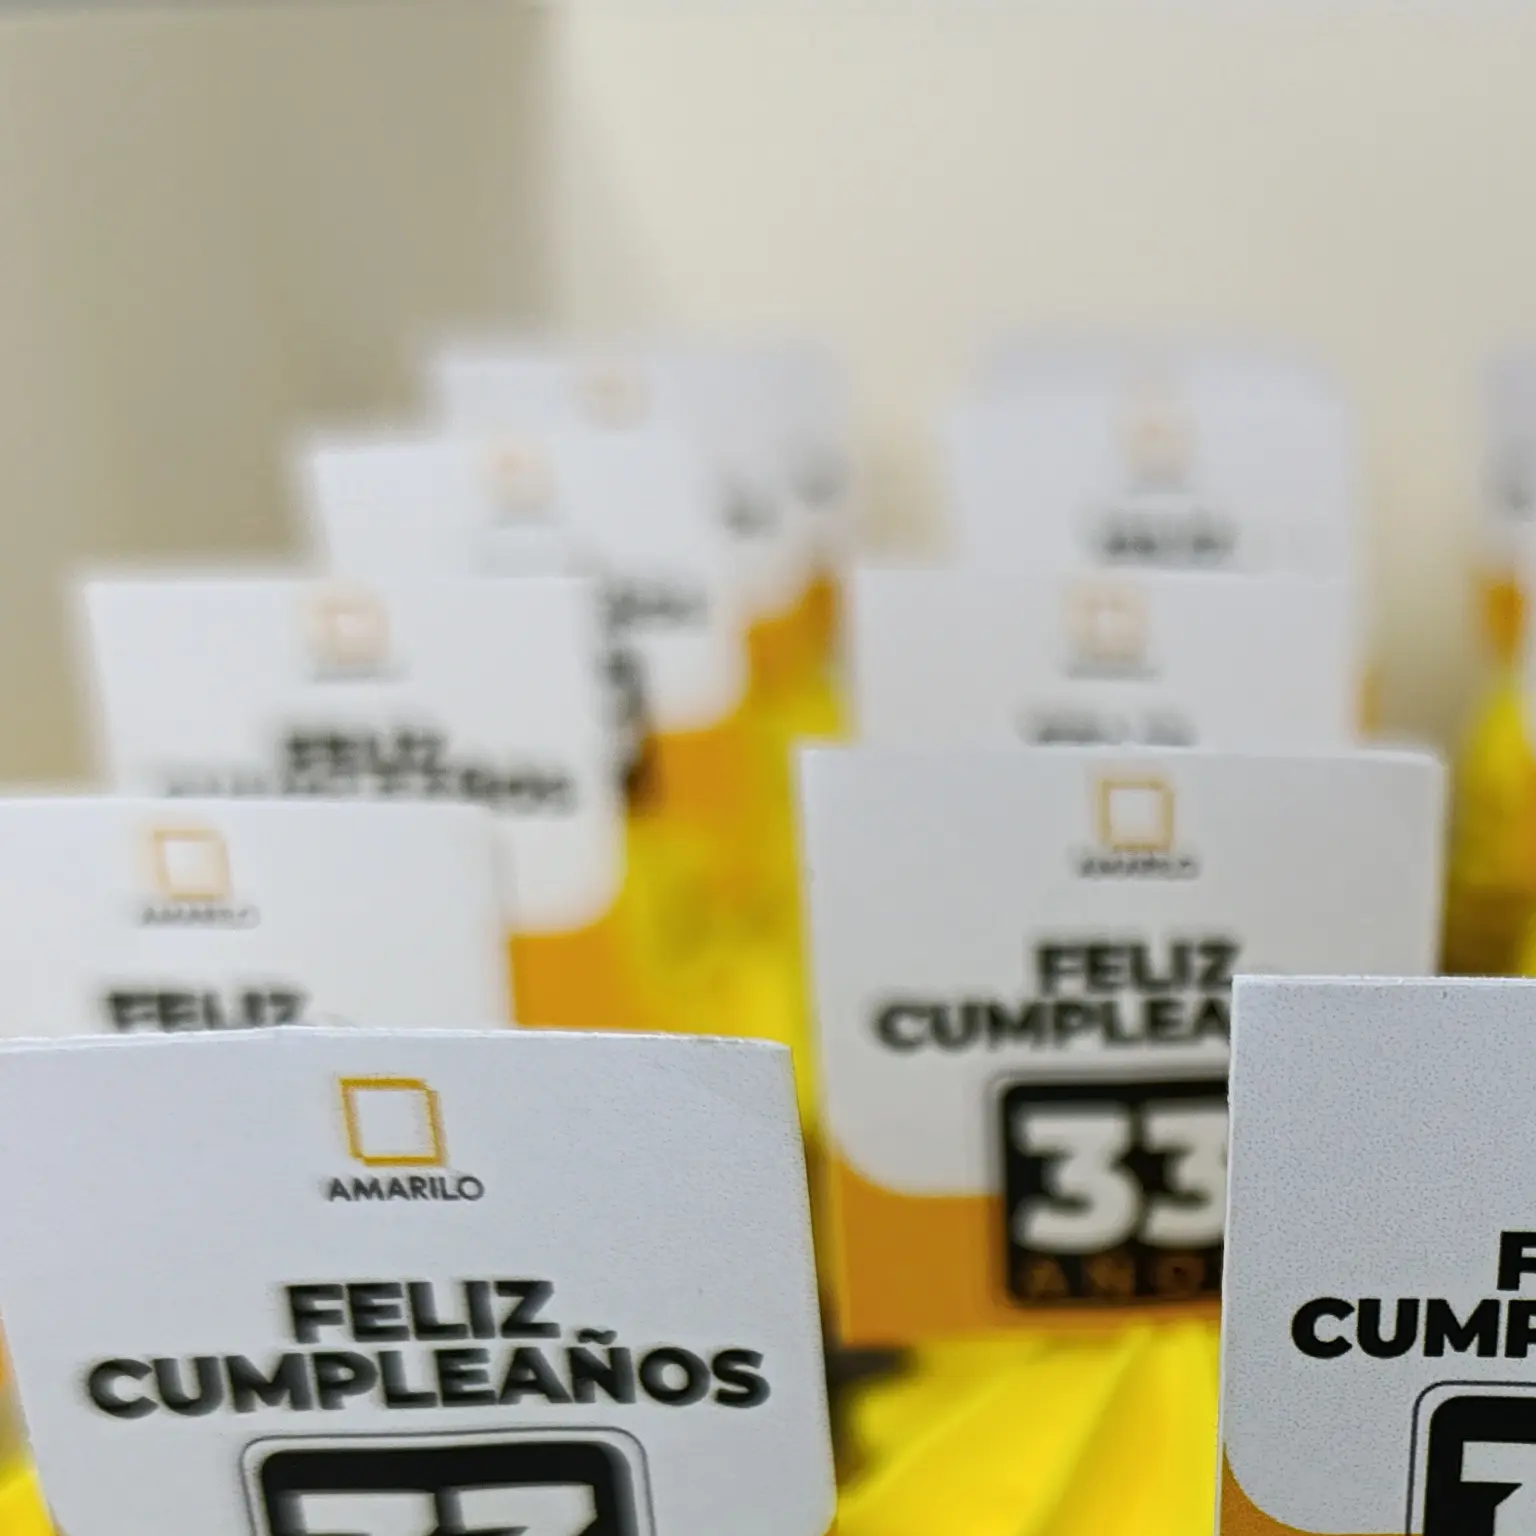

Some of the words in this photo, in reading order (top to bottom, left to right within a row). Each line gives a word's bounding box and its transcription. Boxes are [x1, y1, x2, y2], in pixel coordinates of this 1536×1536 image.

[1034, 938, 1239, 992] FELIZ
[873, 999, 1233, 1051] CUMPLEA
[328, 1175, 485, 1202] AMARILO
[1016, 1108, 1229, 1252] 33
[284, 1280, 560, 1344] FELIZ
[85, 1328, 770, 1419] CUMPLEAÑOS
